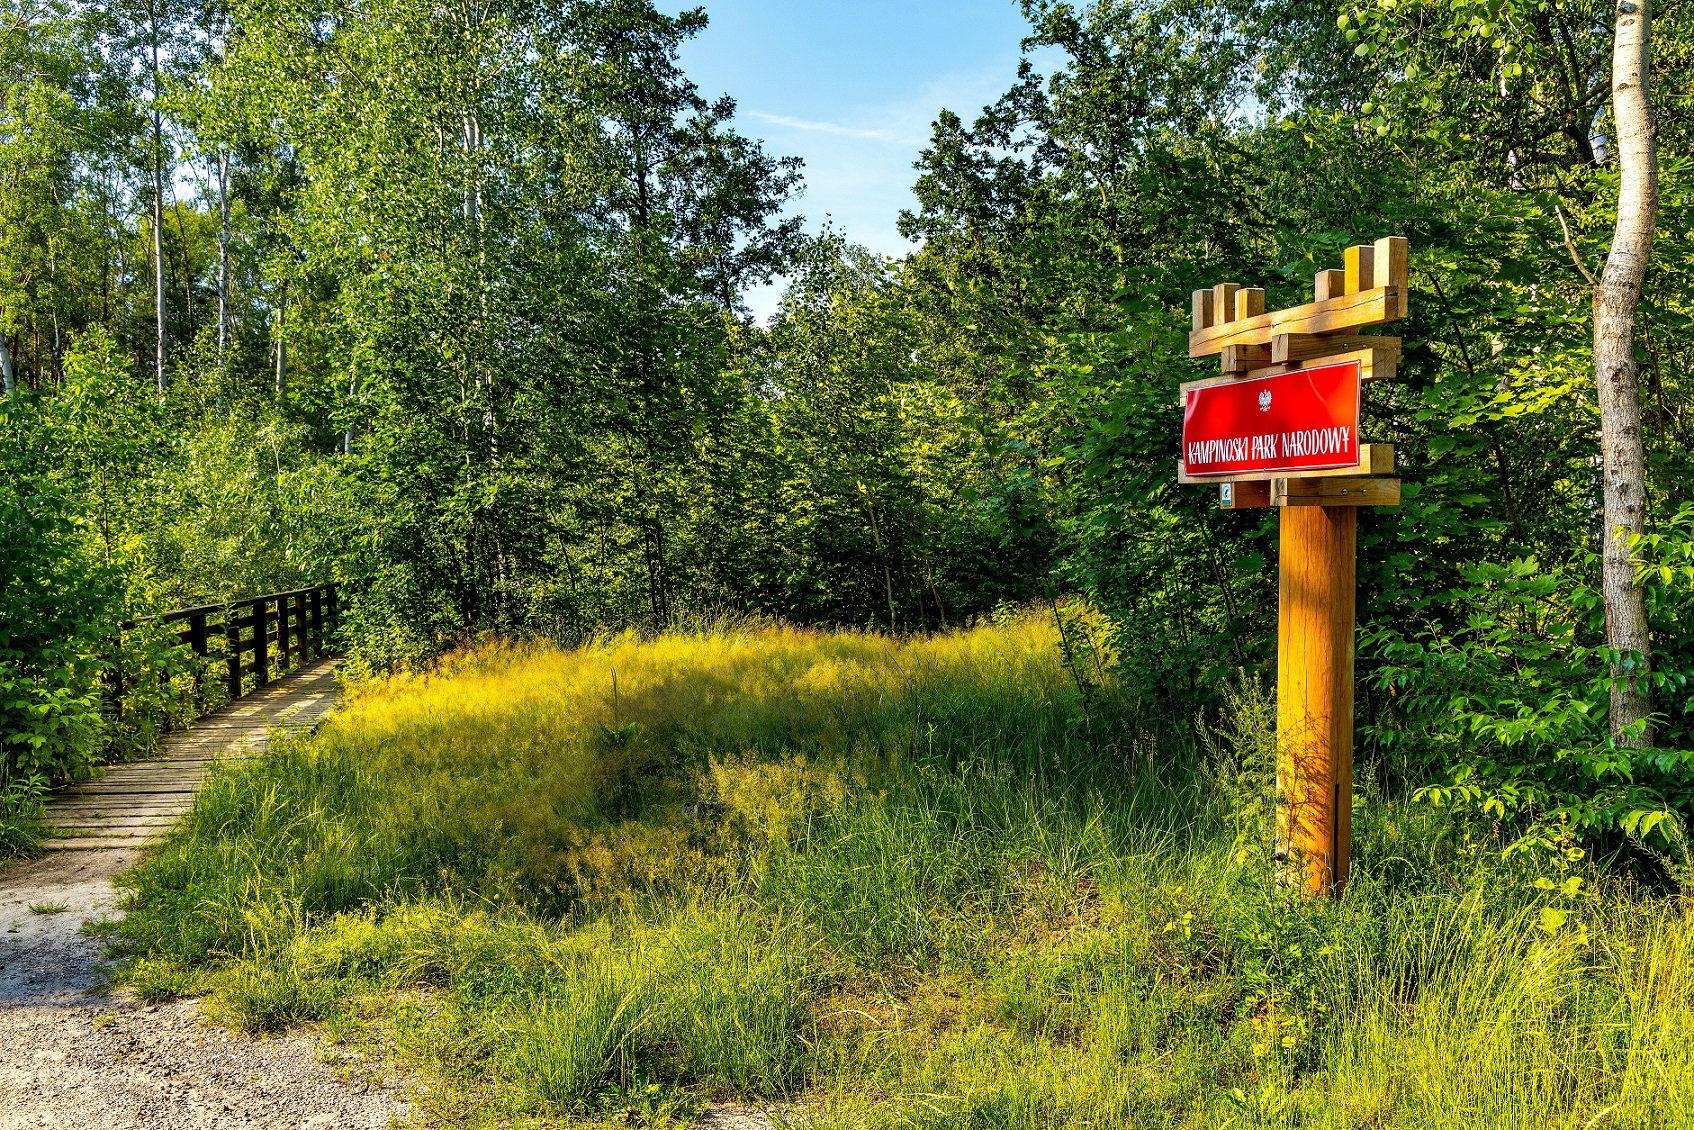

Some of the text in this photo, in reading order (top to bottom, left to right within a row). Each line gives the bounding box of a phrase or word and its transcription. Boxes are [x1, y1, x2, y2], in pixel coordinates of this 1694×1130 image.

[1188, 426, 1350, 464] KAMPINOSKI PARK NARODOWY
